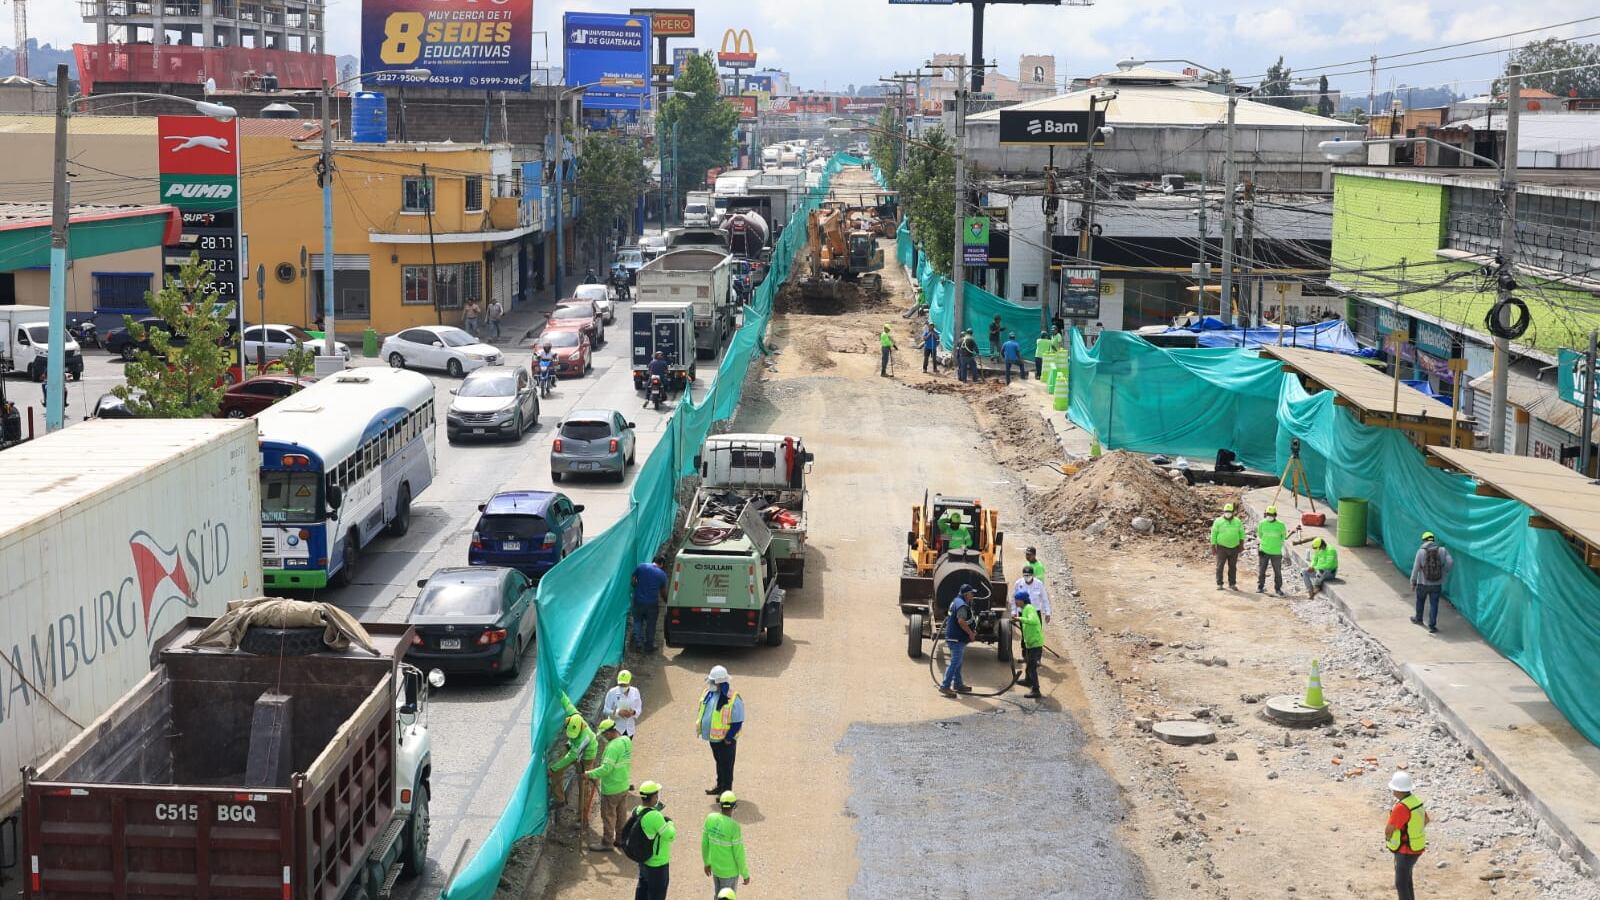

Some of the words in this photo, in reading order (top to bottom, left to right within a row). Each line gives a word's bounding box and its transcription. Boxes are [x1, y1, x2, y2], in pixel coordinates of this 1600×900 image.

[429, 11, 450, 20] MUY
[452, 11, 484, 20] CERCA
[487, 11, 500, 20] DE
[502, 11, 512, 20] TI
[380, 12, 426, 65] 8
[425, 22, 512, 43] SEDES
[588, 29, 624, 37] UNIVERSIDAD
[600, 38, 641, 46] GUATEMALA
[424, 45, 511, 58] EDUCATIVAS
[1044, 120, 1078, 133] Bam
[165, 183, 233, 198] PUMA
[201, 236, 233, 249] 28.77
[0, 576, 136, 724] AMBURG
[186, 519, 229, 594] SÜD
[156, 803, 199, 820] C515
[217, 804, 256, 822] BGQ
